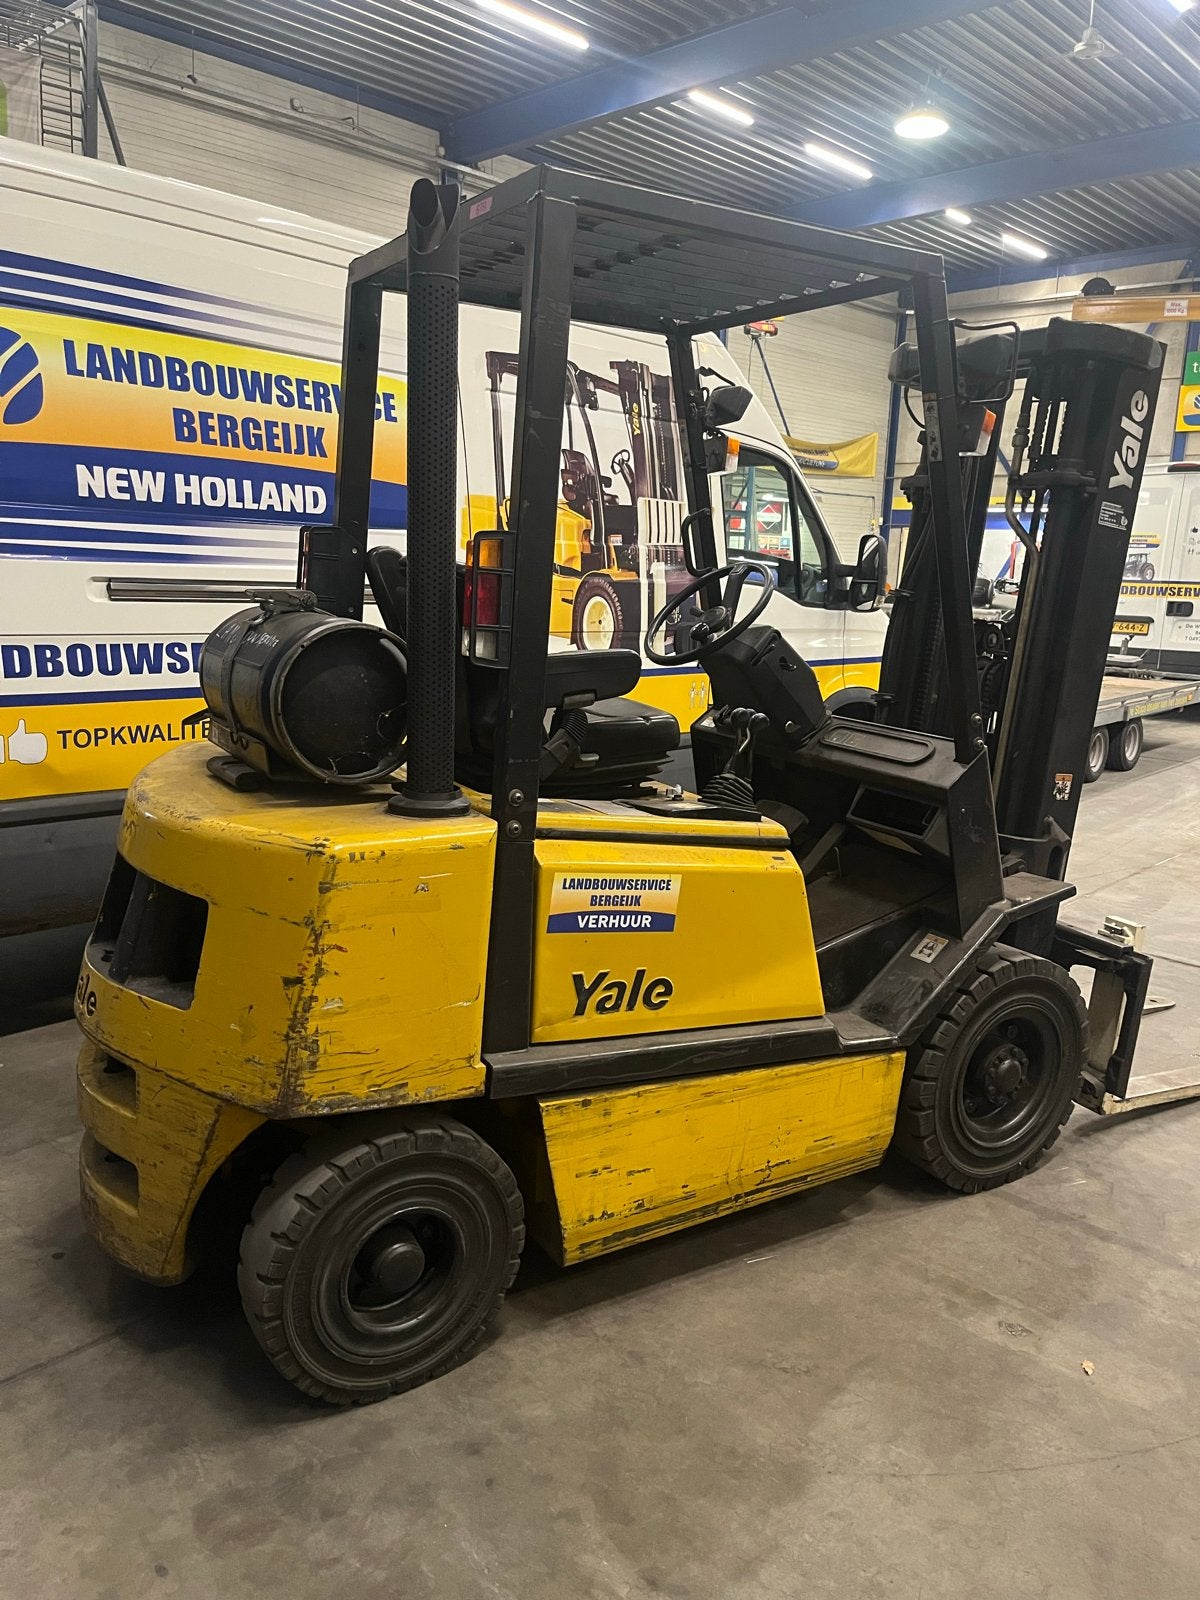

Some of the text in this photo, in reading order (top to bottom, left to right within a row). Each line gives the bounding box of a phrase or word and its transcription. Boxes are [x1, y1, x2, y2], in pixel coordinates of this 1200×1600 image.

[171, 407, 328, 459] BERGEIJK
[1108, 389, 1149, 490] Yale
[75, 464, 327, 515] NEW HOLLAND
[562, 877, 672, 891] LANDBOUWSERVICE
[590, 894, 642, 907] BERGEIJK
[577, 914, 652, 928] VERHUUR
[571, 968, 674, 1017] Yale
